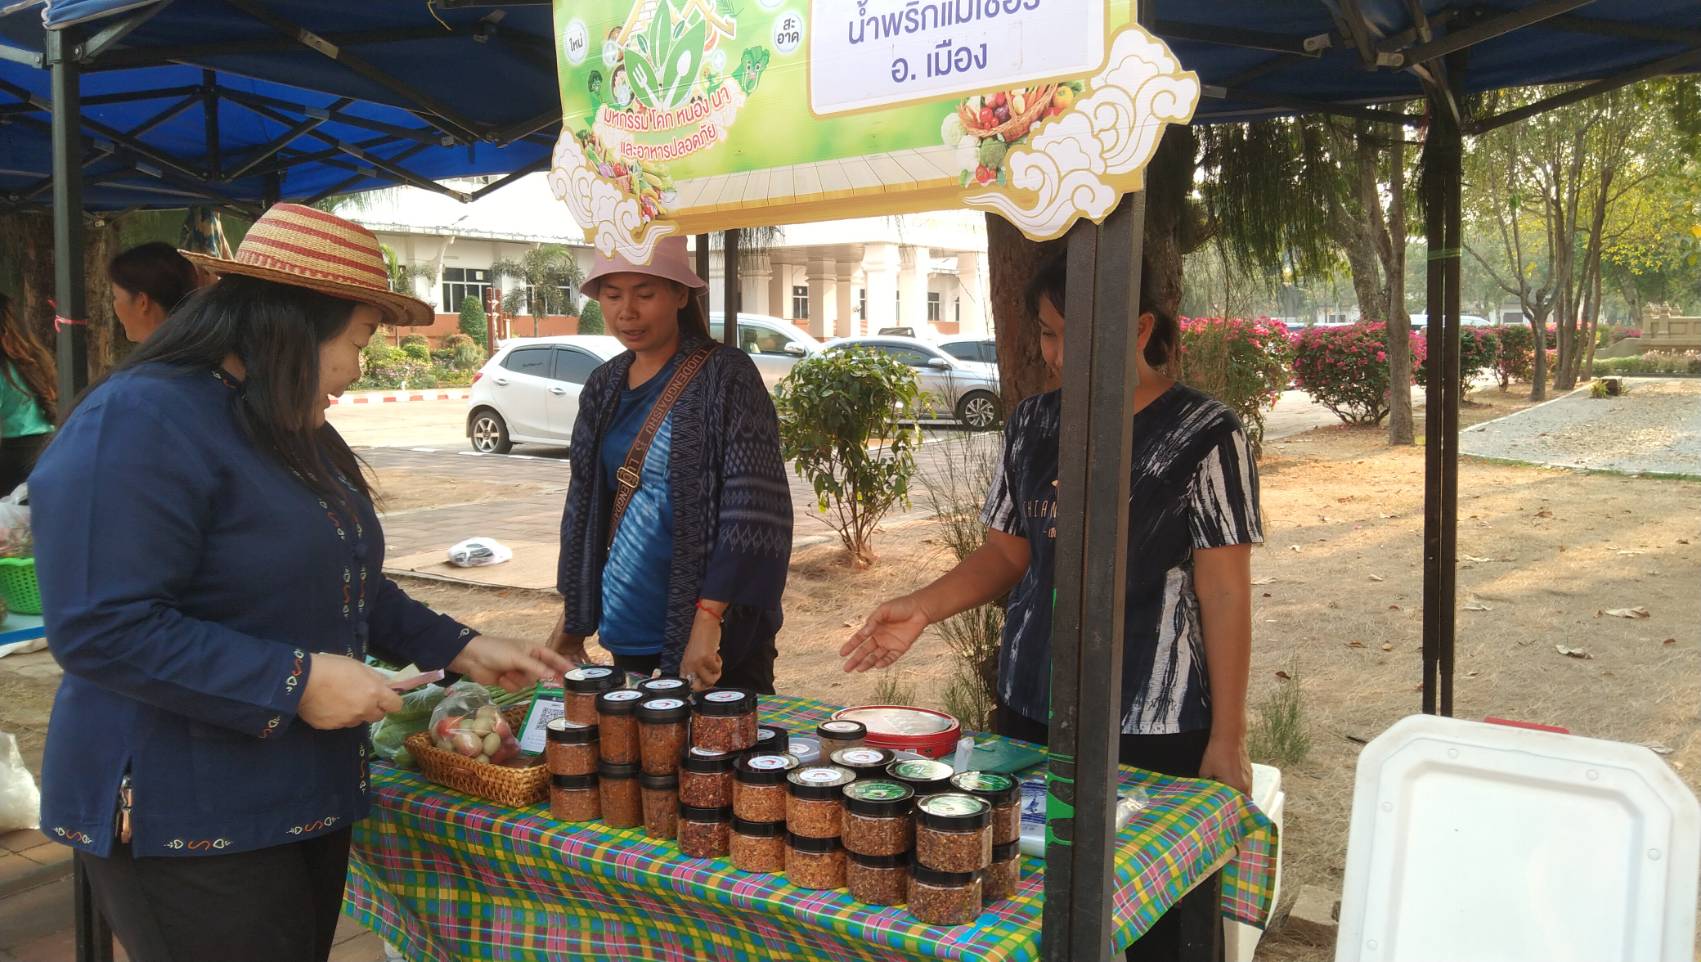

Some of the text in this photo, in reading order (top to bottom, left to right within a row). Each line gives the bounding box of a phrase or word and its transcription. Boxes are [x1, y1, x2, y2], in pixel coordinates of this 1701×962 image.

[891, 39, 988, 84] อ. เมือง
[676, 98, 710, 125] หนอง
[711, 86, 731, 108] นา
[620, 124, 717, 160] และอาหารปลอดภัย
[645, 348, 708, 434] LUODENGDAISHU
